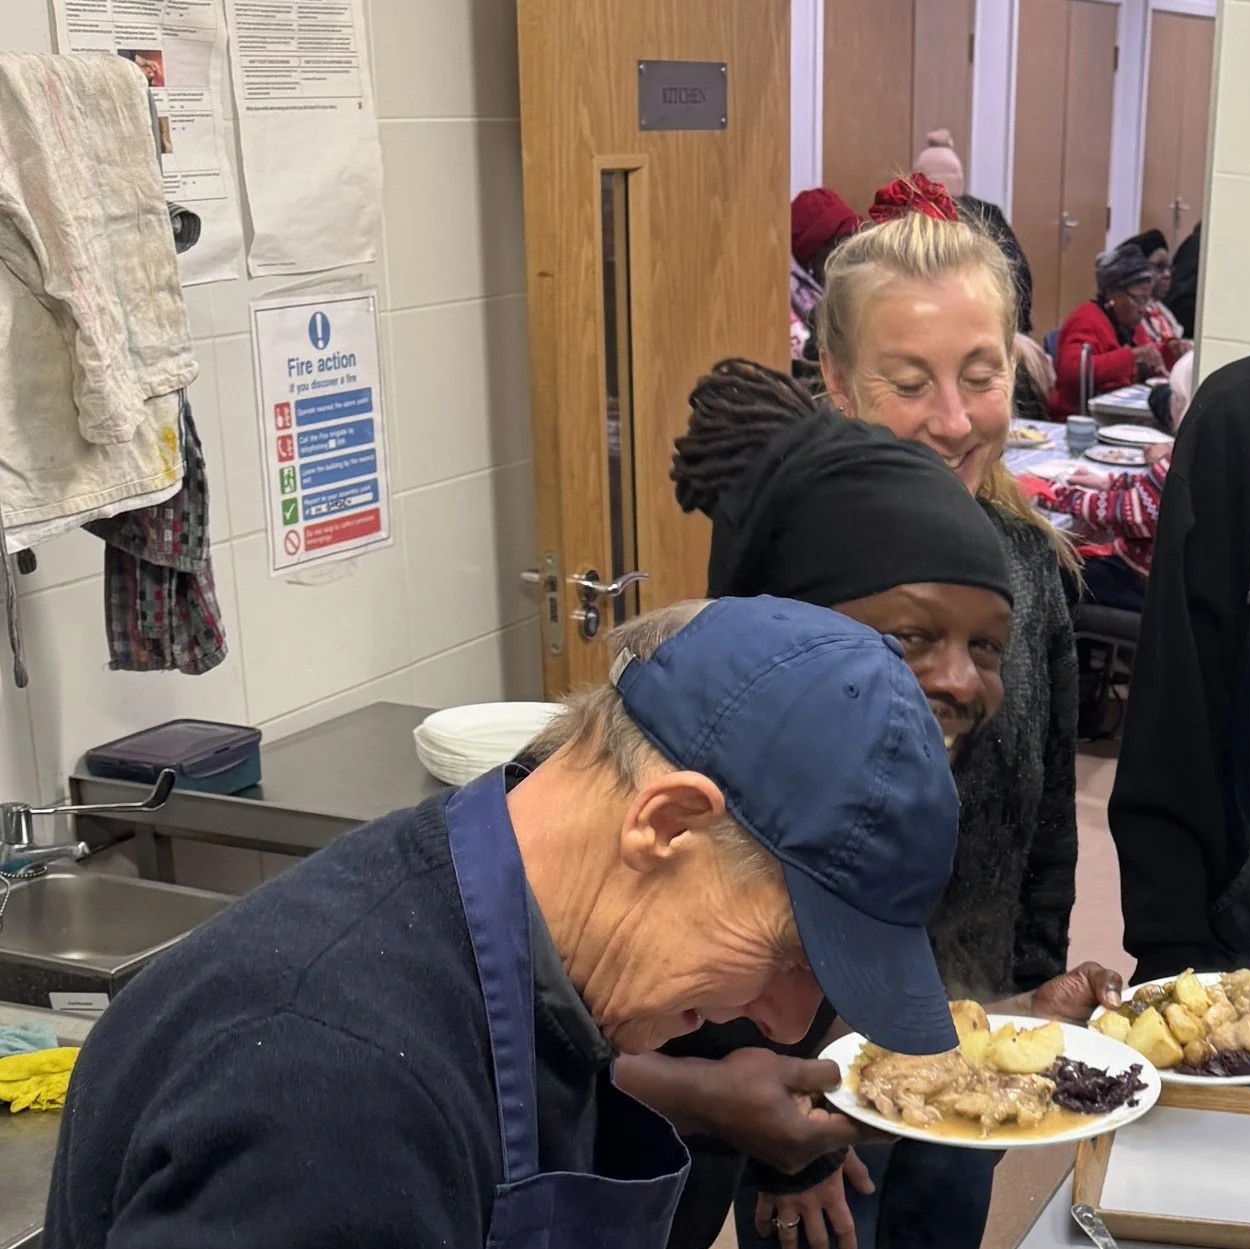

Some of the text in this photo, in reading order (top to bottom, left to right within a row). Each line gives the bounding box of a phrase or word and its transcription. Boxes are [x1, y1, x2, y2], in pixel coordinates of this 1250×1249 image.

[287, 351, 357, 378] Fire action
[296, 382, 310, 395] you
